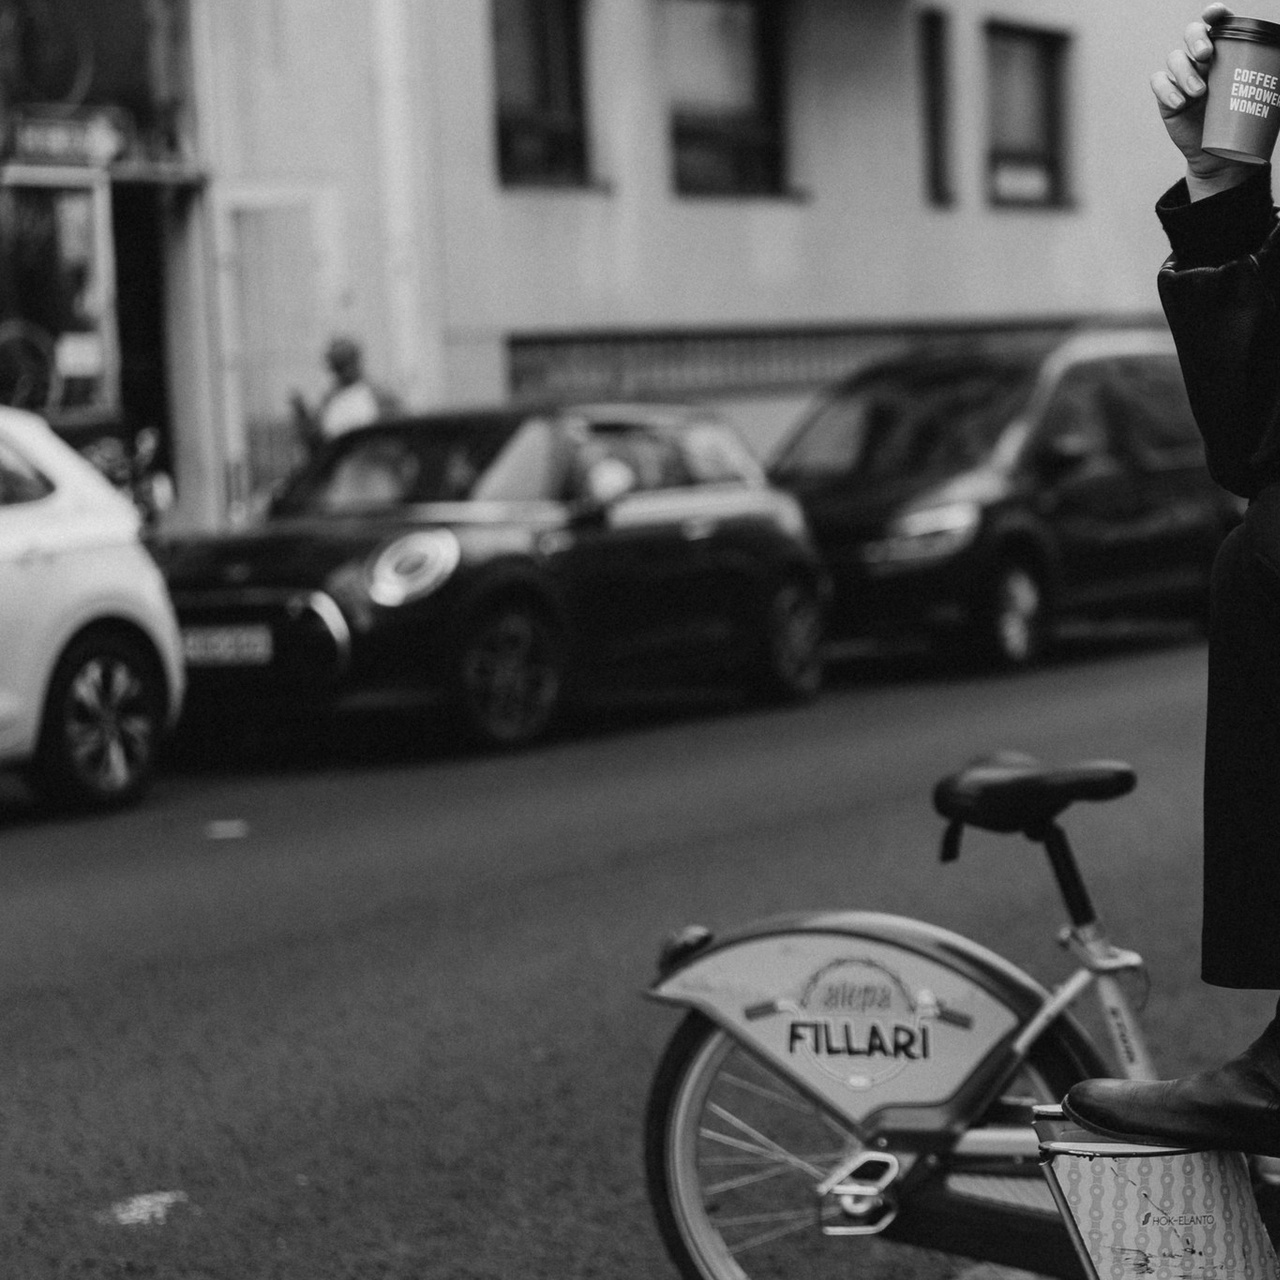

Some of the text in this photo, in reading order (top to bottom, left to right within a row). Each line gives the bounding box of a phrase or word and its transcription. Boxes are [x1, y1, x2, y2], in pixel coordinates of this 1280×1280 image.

[1233, 67, 1279, 90] COFFEE
[1229, 97, 1270, 119] WOMEN
[789, 1022, 930, 1060] FILLARI
[1152, 1214, 1215, 1226] HOK-ELANTO
